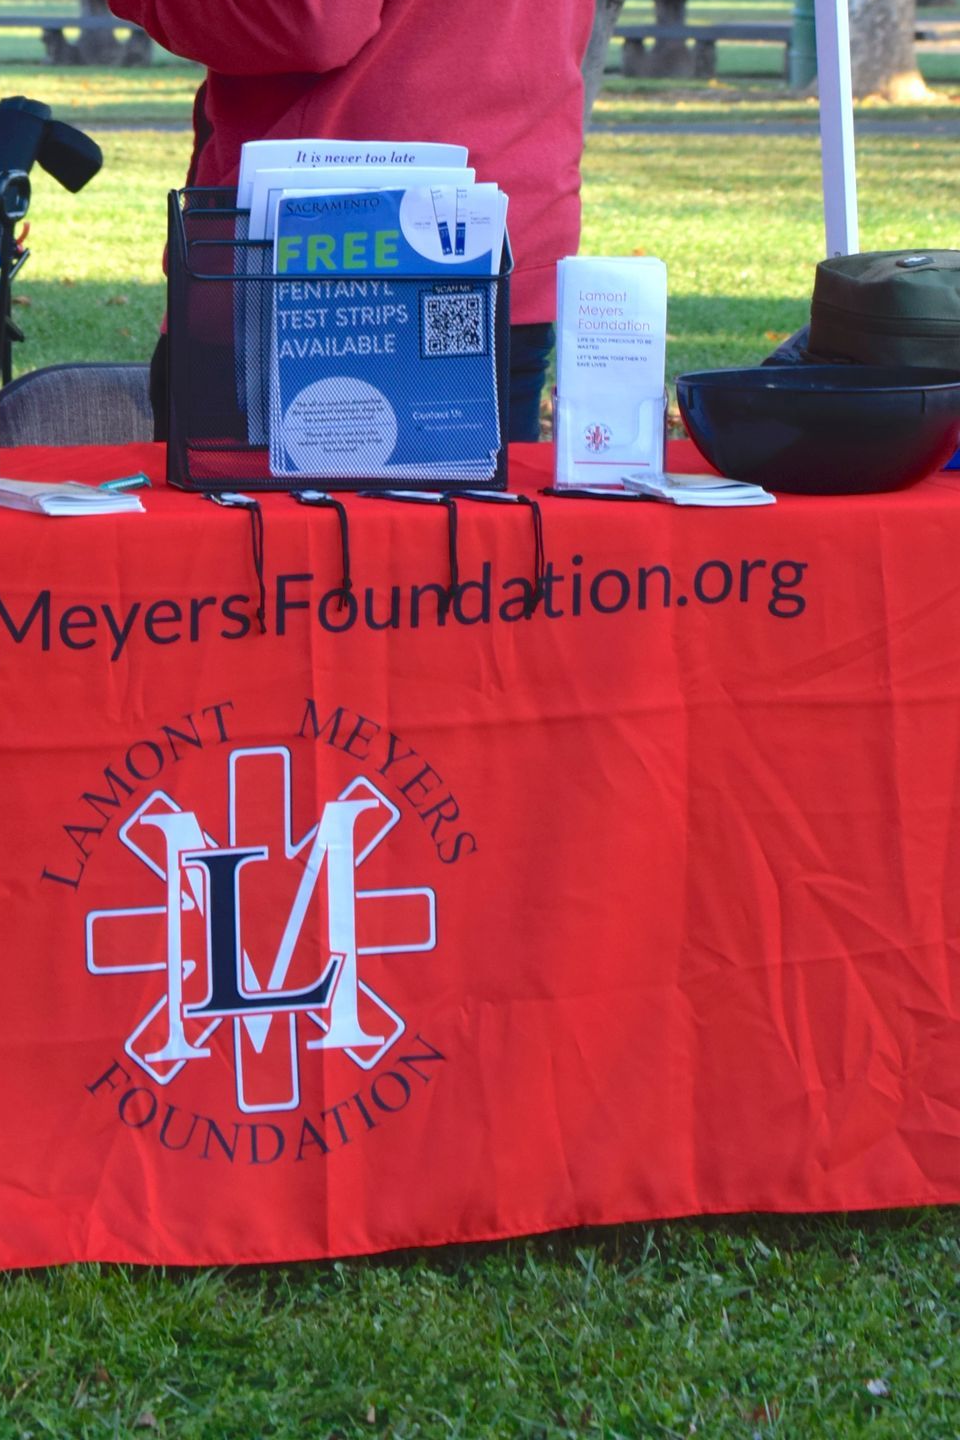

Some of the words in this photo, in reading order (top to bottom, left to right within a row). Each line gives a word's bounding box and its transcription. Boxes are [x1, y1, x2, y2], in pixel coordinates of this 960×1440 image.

[296, 150, 307, 163] It
[311, 151, 321, 163] is
[324, 154, 362, 163] never
[365, 152, 386, 163] too
[390, 151, 415, 163] late
[277, 229, 400, 274] FREE
[278, 279, 395, 301] FENTANYL
[579, 290, 627, 302] Lamont
[279, 308, 329, 330] TEST
[335, 303, 409, 327] STRIPS
[578, 305, 624, 318] Meyers
[578, 318, 651, 332] Foundation
[279, 333, 397, 359] AVAILABLE
[274, 554, 809, 637] Foundation.org
[39, 698, 237, 893] LAMONT
[297, 696, 478, 868] MEYERS
[83, 1031, 450, 1168] FOUNDATION
